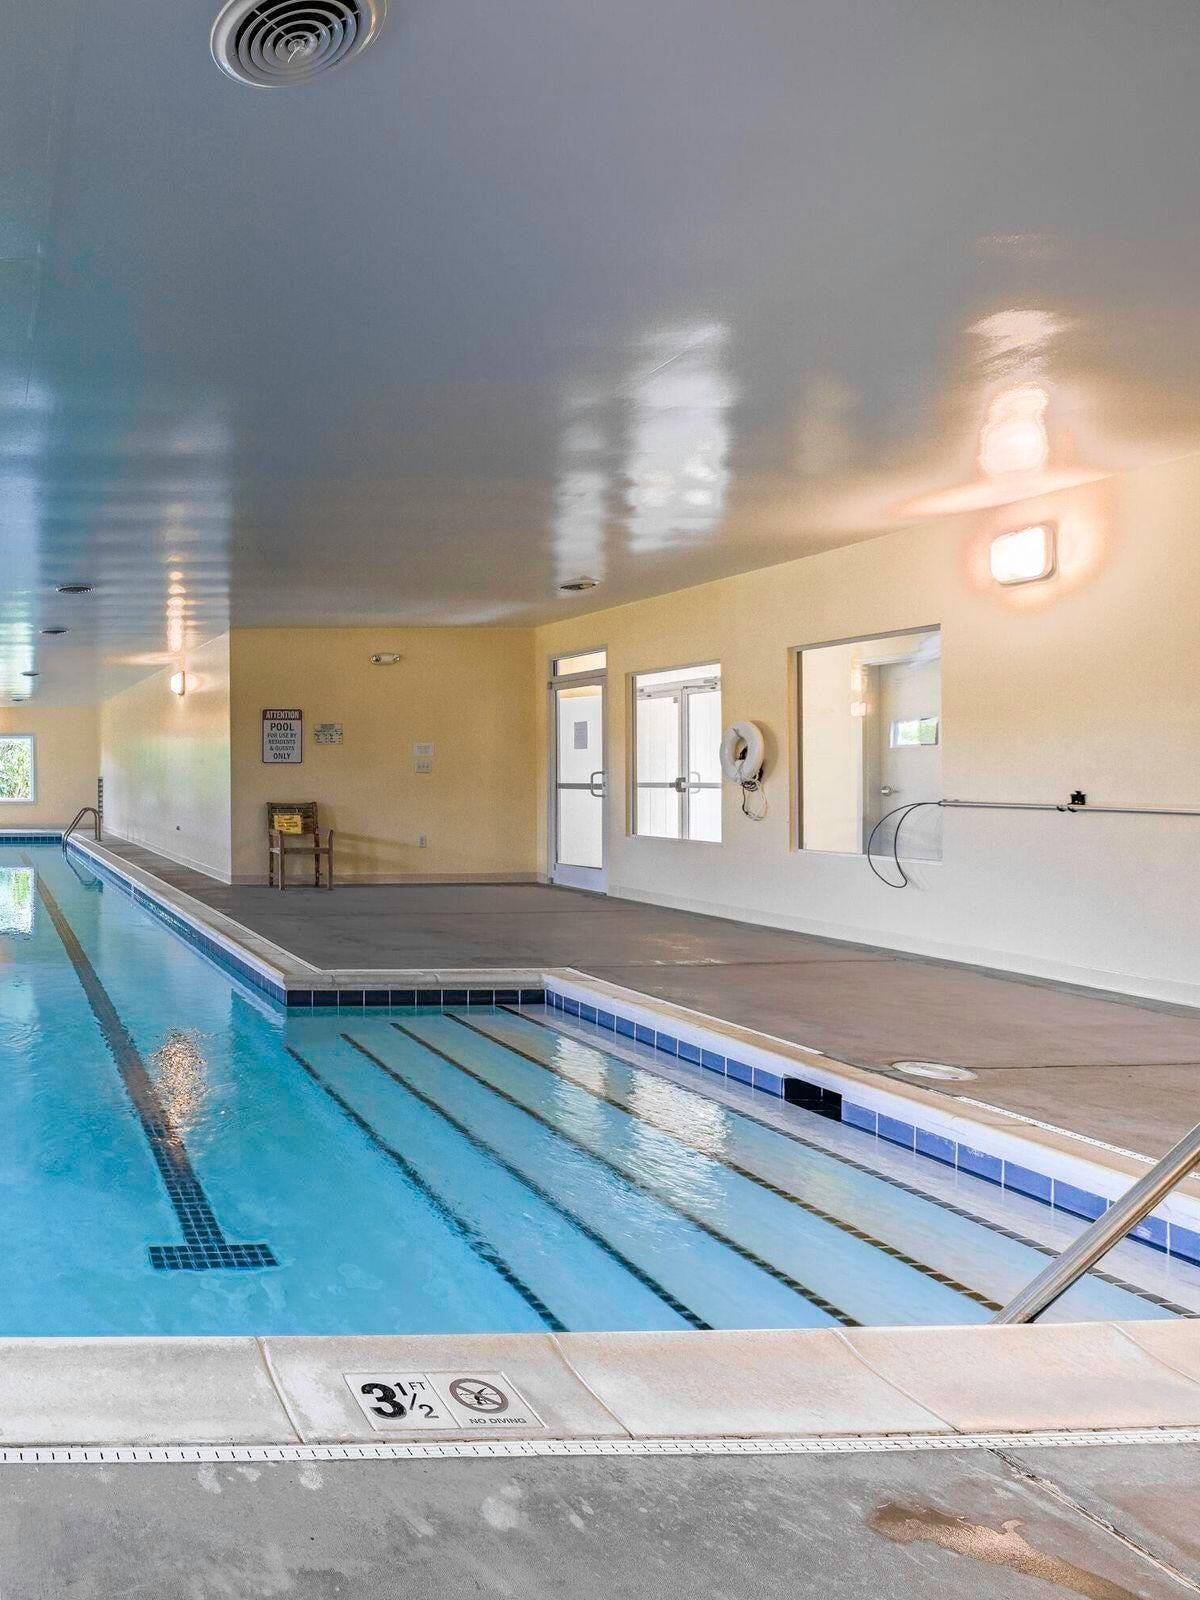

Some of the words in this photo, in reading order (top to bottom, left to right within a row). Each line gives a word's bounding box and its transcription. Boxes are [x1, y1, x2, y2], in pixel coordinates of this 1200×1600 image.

[265, 710, 299, 719] ATTENTION
[270, 722, 294, 731] POOL
[273, 752, 291, 760] ONLY
[408, 1381, 426, 1391] FT
